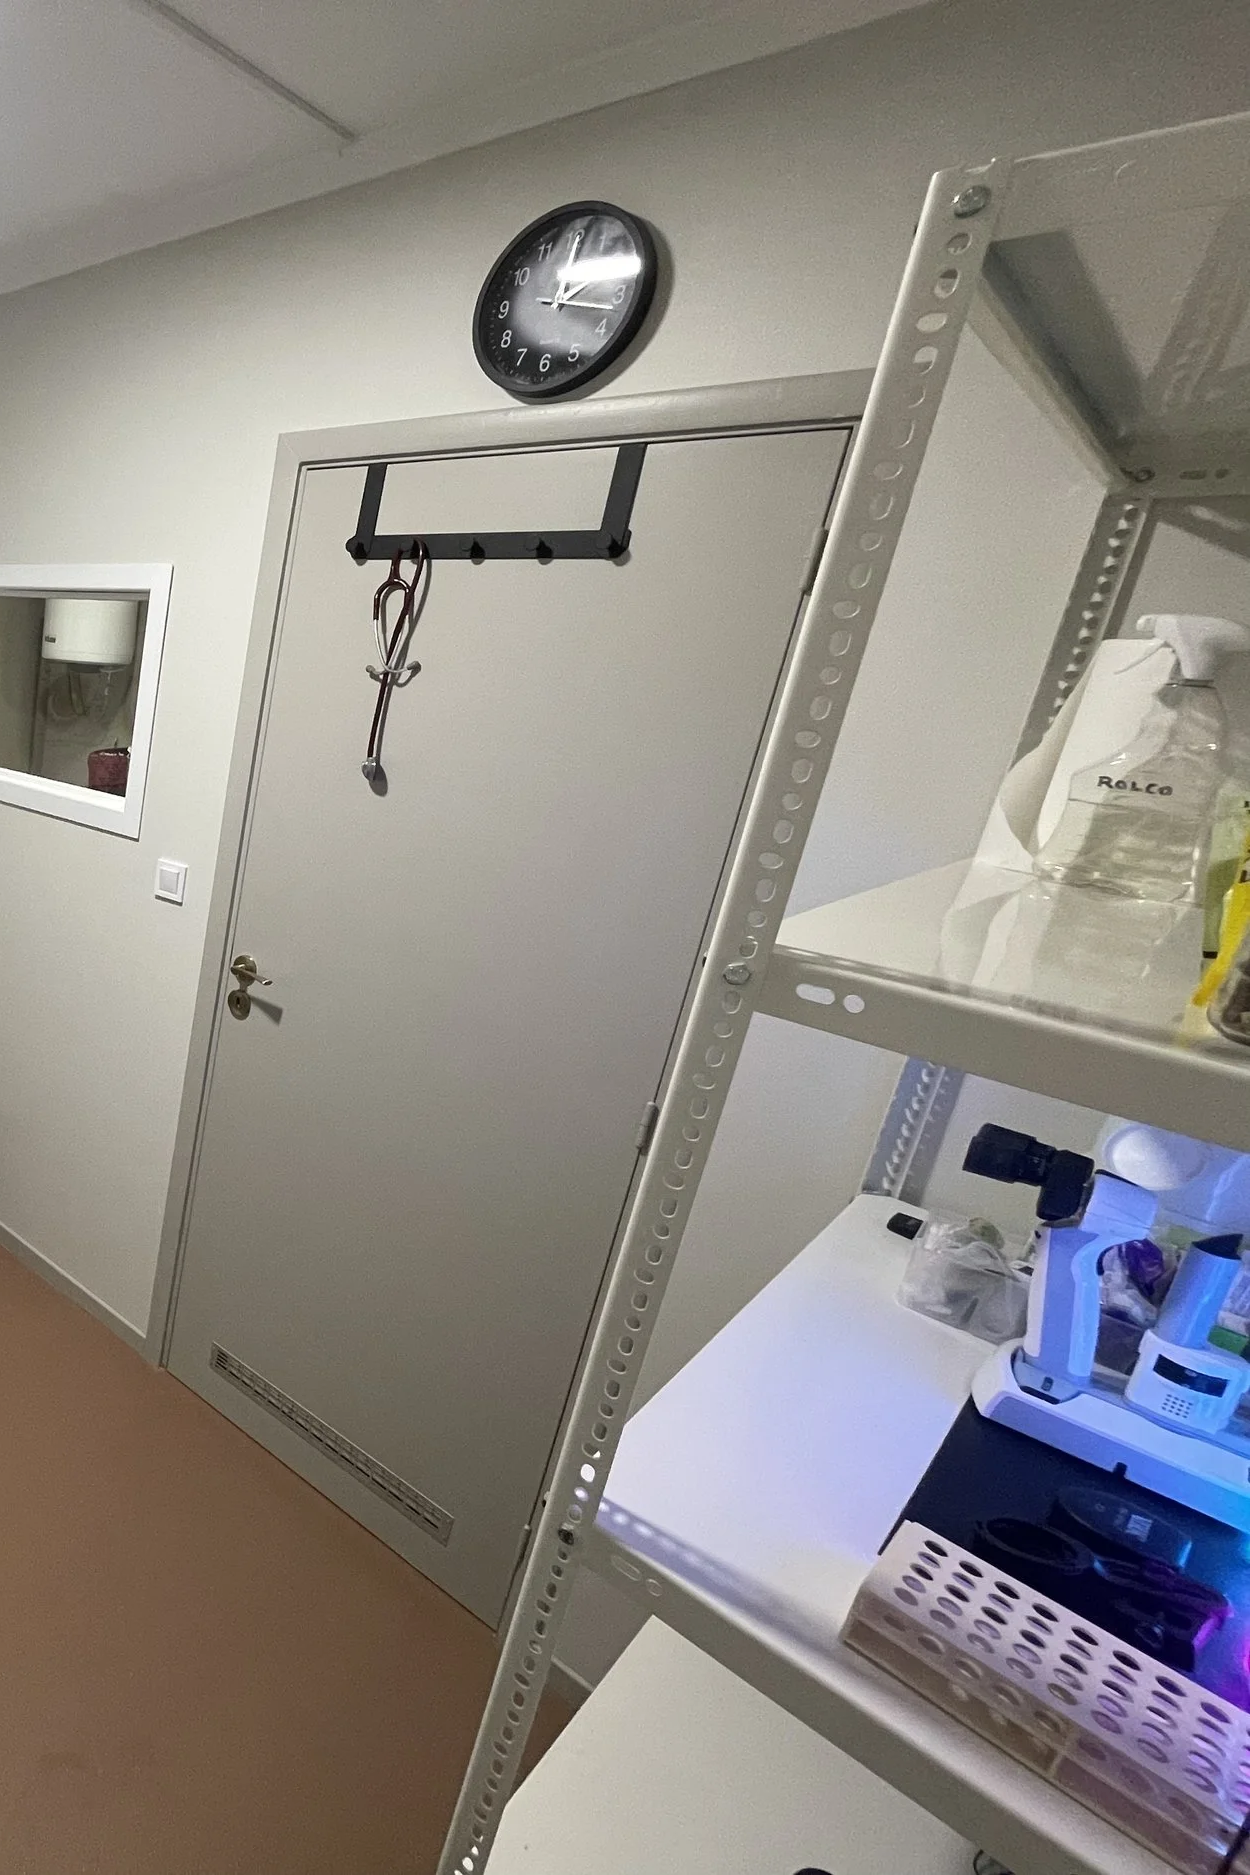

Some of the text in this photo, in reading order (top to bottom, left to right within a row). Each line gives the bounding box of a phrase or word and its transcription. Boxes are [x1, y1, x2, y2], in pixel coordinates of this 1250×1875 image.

[538, 242, 554, 262] 11
[513, 266, 531, 287] 10
[612, 284, 627, 305] 3
[498, 300, 510, 319] 9
[595, 317, 608, 337] 4
[500, 329, 512, 348] 8
[515, 348, 527, 367] 7
[538, 353, 551, 372] 6
[567, 343, 581, 363] 5
